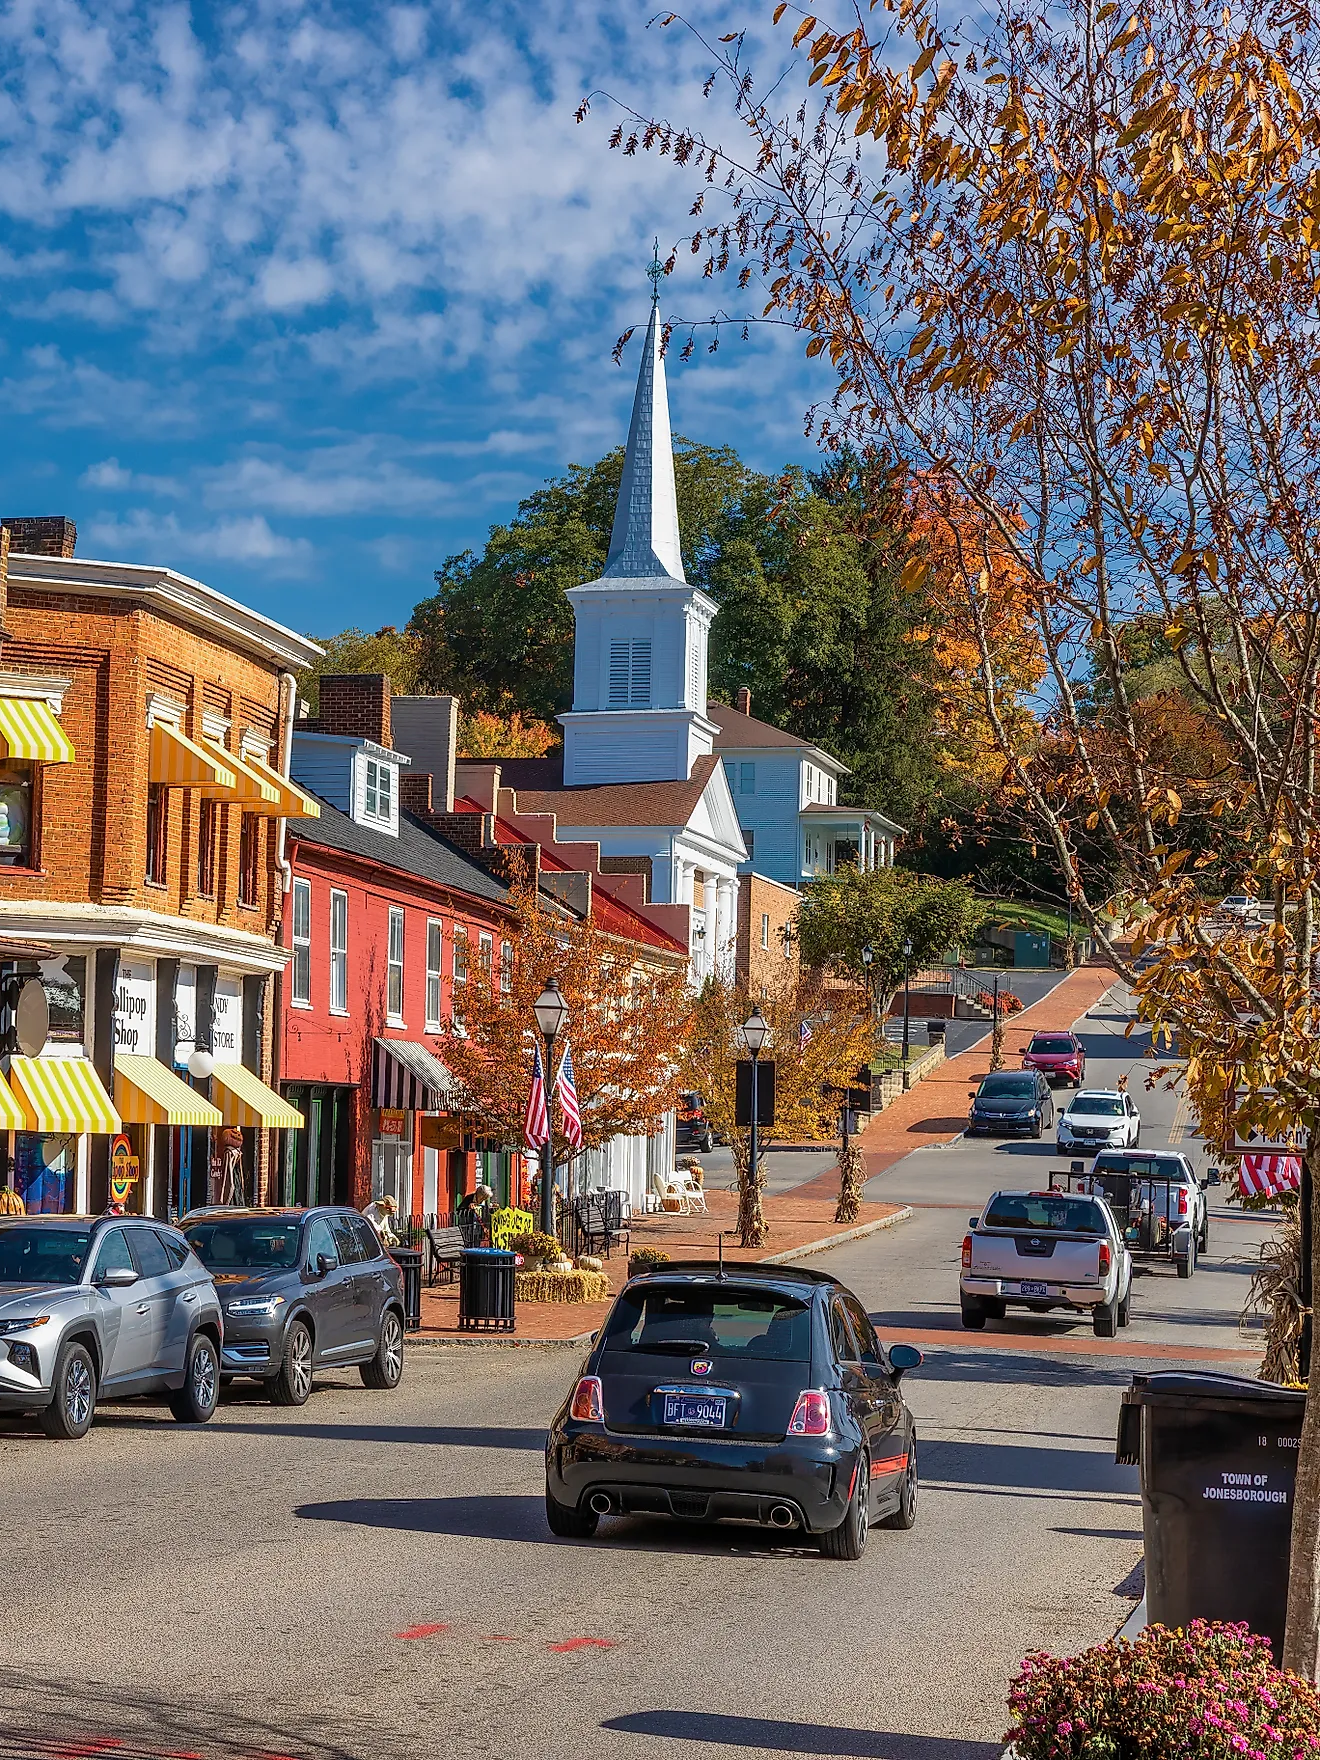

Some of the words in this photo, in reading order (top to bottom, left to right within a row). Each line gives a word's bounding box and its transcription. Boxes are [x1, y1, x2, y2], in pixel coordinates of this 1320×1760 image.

[122, 969, 132, 981] THE
[116, 986, 147, 1020] llipop
[214, 998, 229, 1014] NDY
[114, 1019, 138, 1052] Shop
[214, 1031, 235, 1049] STORE
[667, 1403, 687, 1417] BFT
[697, 1404, 722, 1420] 9044
[1258, 1436, 1267, 1447] 18
[1221, 1472, 1252, 1486] TOWN
[1253, 1474, 1268, 1486] OF
[1202, 1487, 1287, 1504] JONESBOROUGH
